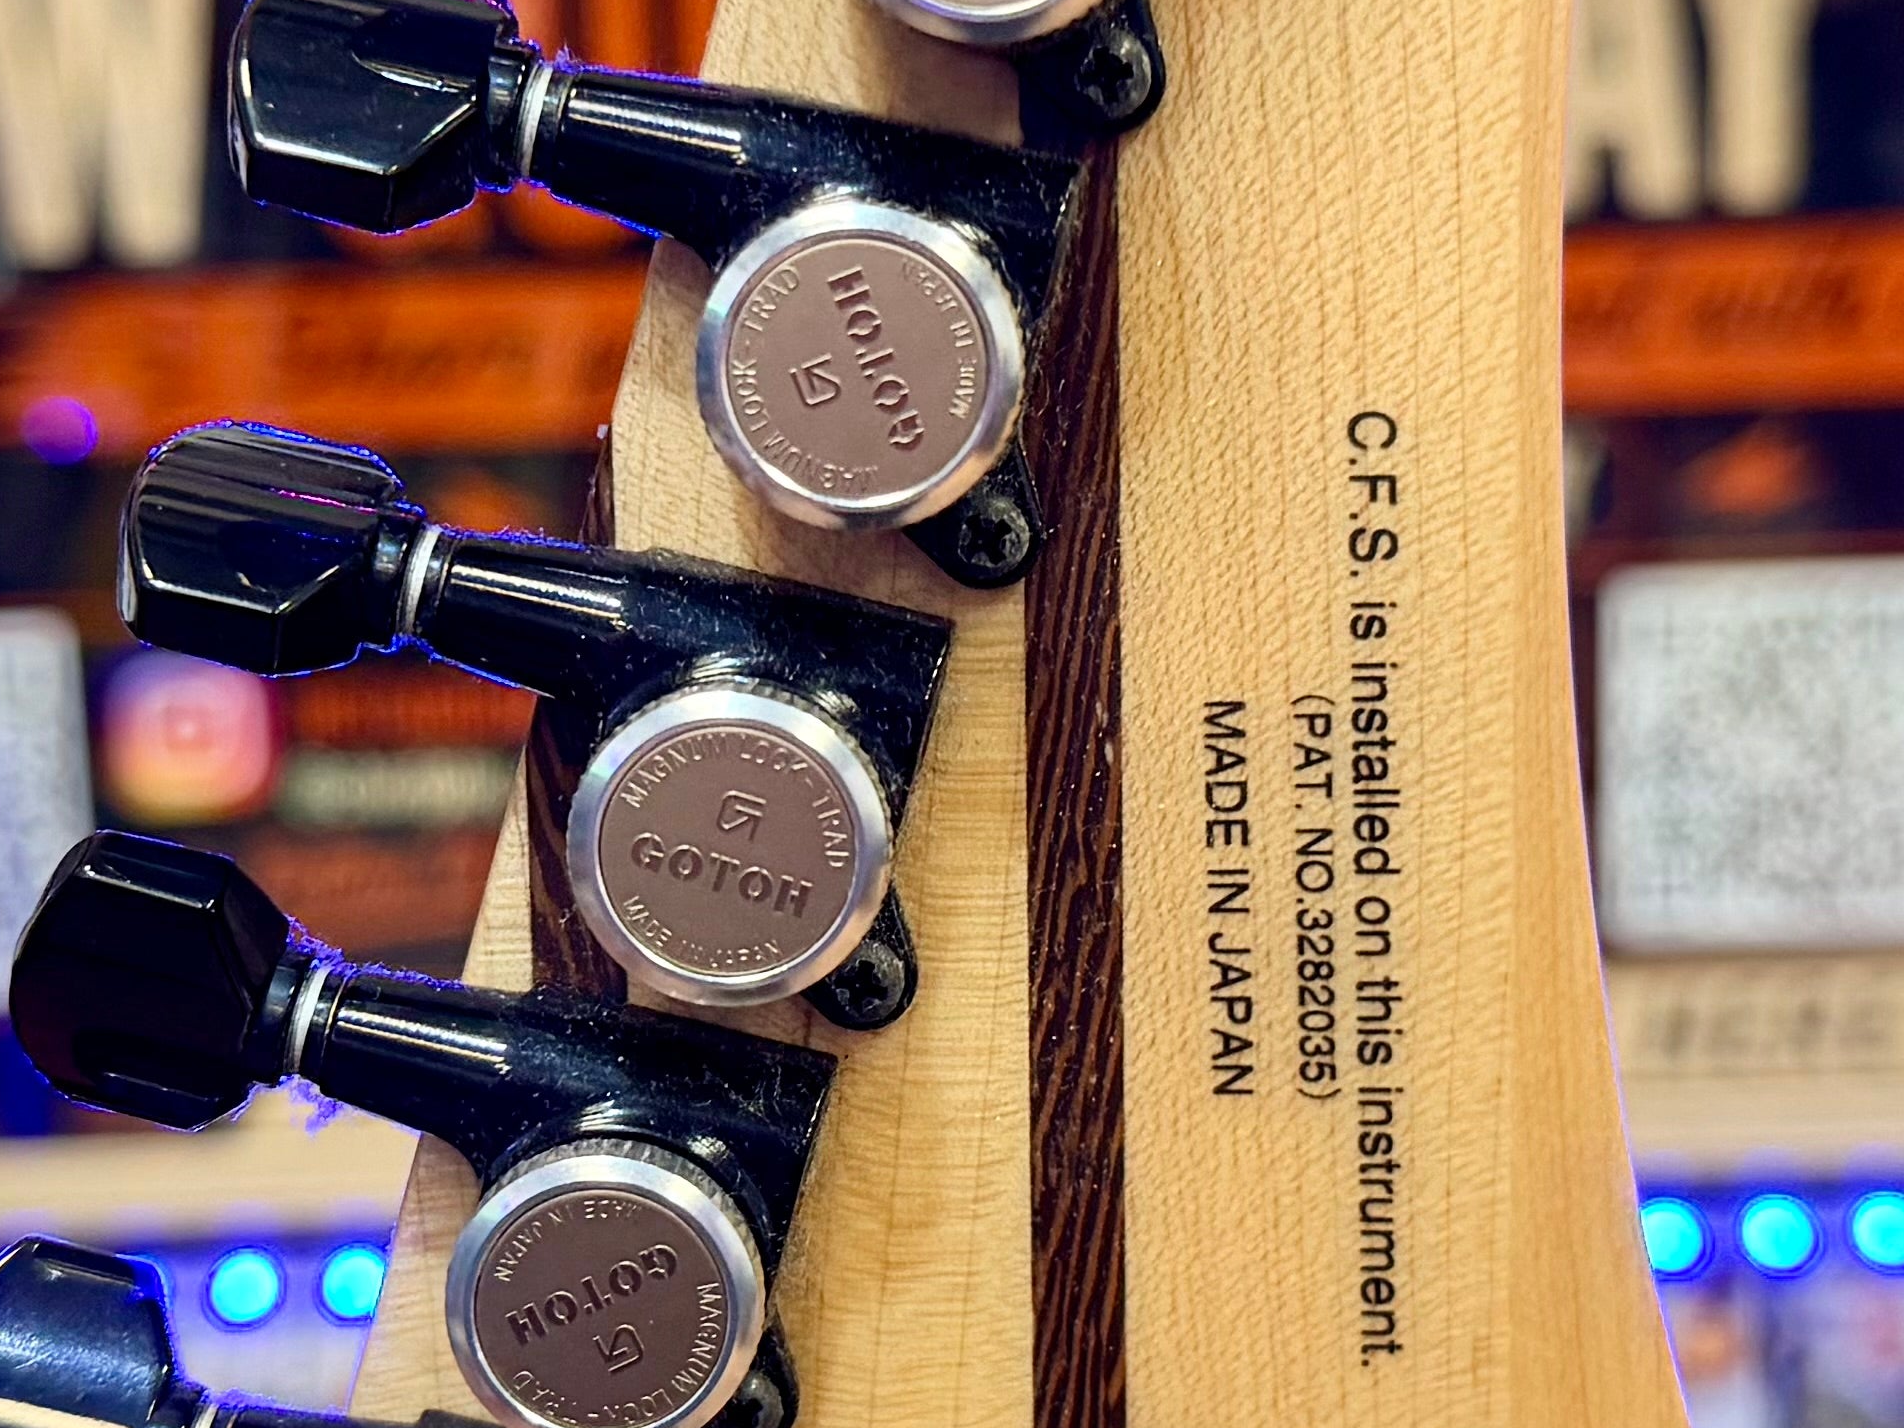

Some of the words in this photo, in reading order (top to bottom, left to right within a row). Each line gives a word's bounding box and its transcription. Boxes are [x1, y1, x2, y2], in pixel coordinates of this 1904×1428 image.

[826, 266, 925, 451] GOTOH
[1348, 412, 1398, 576] C.F.S.
[1350, 602, 1396, 640] is
[620, 731, 727, 808] MAGNUM
[1204, 701, 1249, 848] MADE
[1291, 695, 1335, 809] (PAT.
[1352, 663, 1401, 875] installed
[623, 896, 673, 947] MADE
[630, 832, 814, 919] GOTOH
[1207, 869, 1250, 913] IN
[1355, 896, 1391, 956] on
[1208, 932, 1253, 1095] JAPAN
[1295, 828, 1341, 1100] NO.3282035)
[1356, 977, 1403, 1065] this
[1358, 1087, 1403, 1366] instrument.
[505, 1244, 679, 1346] GOTOH
[671, 1282, 723, 1393] MAGNUM
